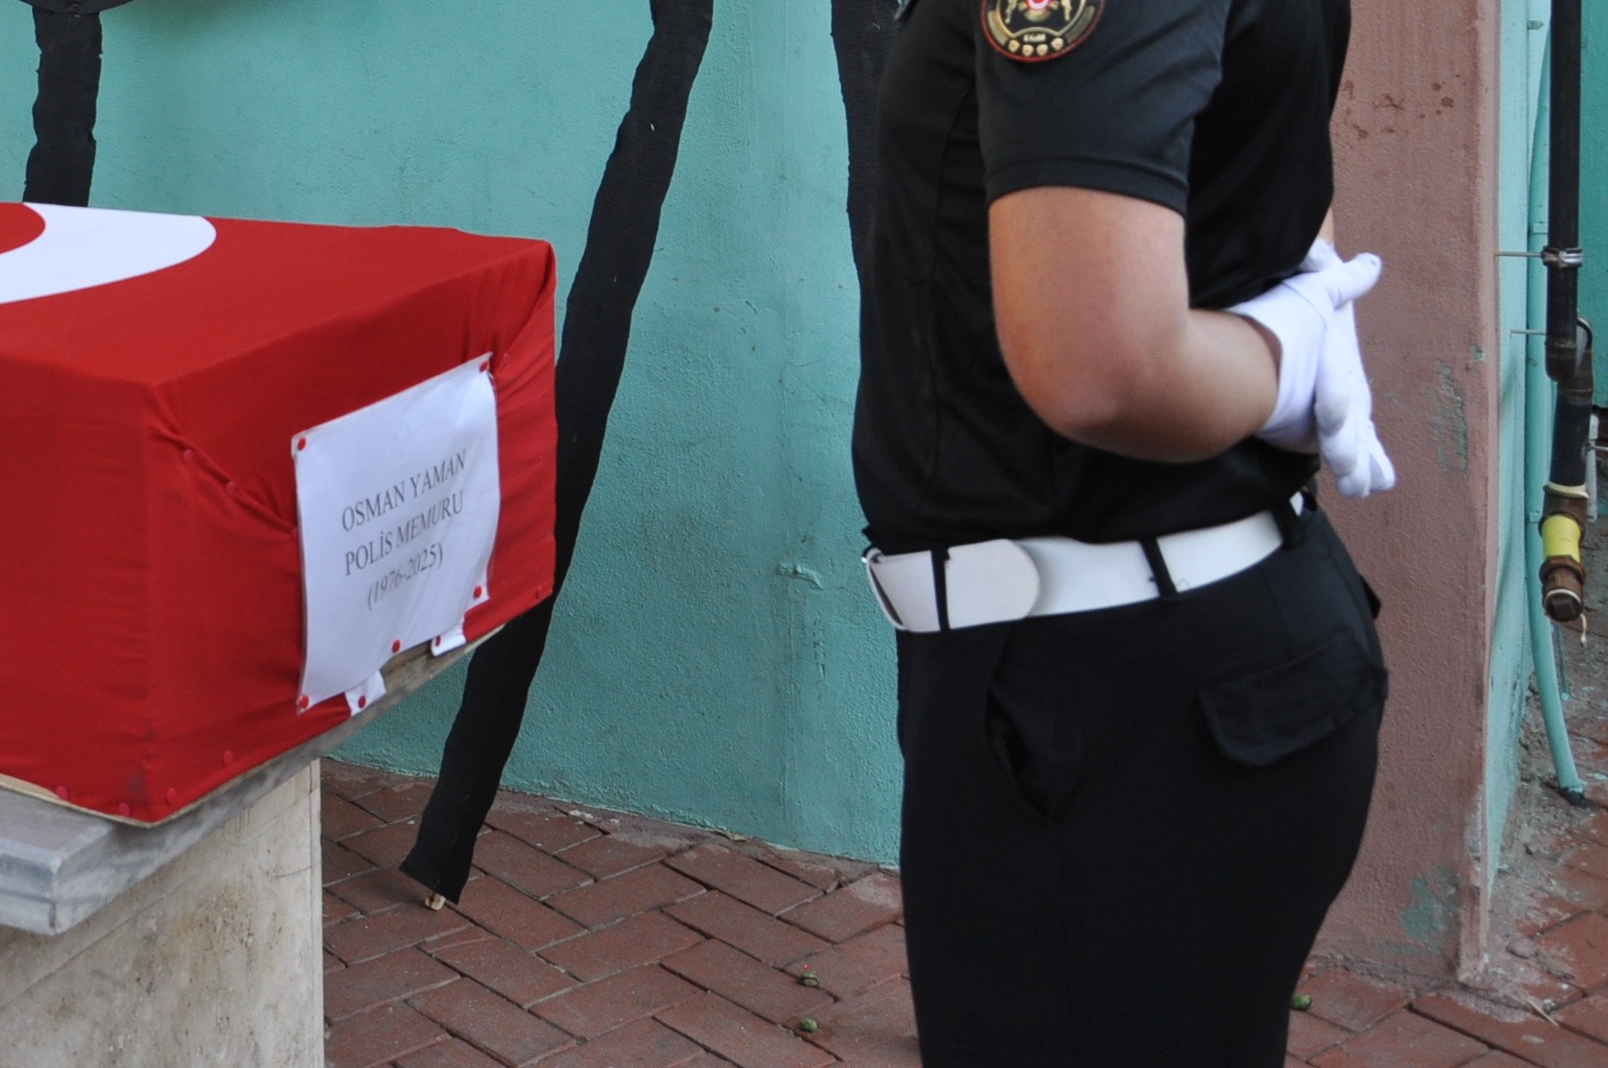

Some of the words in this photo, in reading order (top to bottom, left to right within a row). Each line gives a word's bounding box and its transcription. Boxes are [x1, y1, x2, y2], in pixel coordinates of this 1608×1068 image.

[341, 480, 405, 532] OSMAN
[410, 449, 467, 498] YAMAN
[345, 530, 392, 577] POLİS
[396, 490, 465, 549] MEMURU
